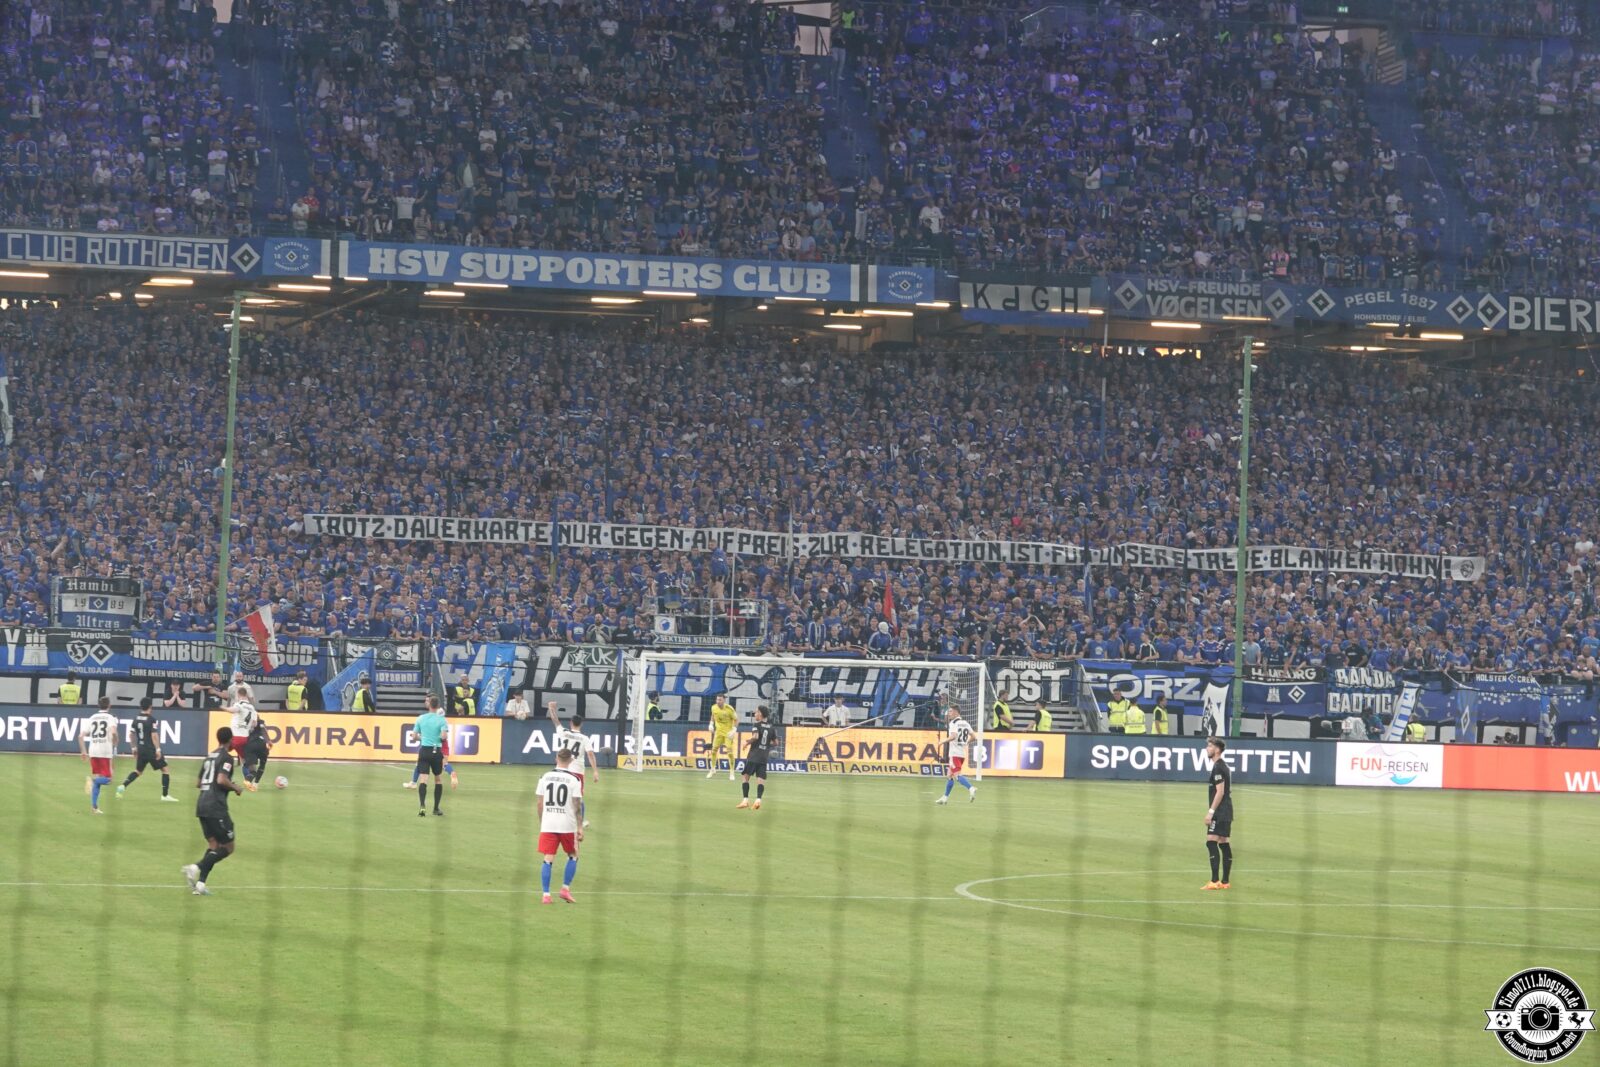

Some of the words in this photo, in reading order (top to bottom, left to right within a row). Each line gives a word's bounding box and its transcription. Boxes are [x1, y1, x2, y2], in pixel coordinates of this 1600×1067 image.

[7, 233, 77, 262] CLUB
[87, 237, 229, 270] ROTHOSEN
[368, 248, 450, 277] HSV
[460, 252, 723, 290] SUPPORTERS
[733, 264, 831, 294] CLUB
[1344, 291, 1395, 308] PEGEL
[1400, 293, 1438, 311] 1887
[1508, 296, 1600, 333] BIER
[312, 516, 385, 538] TROTZ
[394, 518, 548, 543] DAUERKARTE
[558, 524, 601, 544] NUR
[611, 526, 684, 549] GEGEN
[808, 535, 849, 555] ZUR
[860, 536, 1000, 562] RELEGATION
[1010, 543, 1043, 562] IST
[1192, 549, 1263, 569] TREE
[1270, 549, 1371, 569] BLANKER
[66, 578, 120, 593] Hamb
[70, 631, 112, 640] HAMBURG
[660, 634, 690, 643] SEKTION
[865, 653, 912, 661] ULTRAS
[1011, 660, 1056, 670] HAMBURG
[166, 670, 213, 680] VERSTORBENE
[1335, 666, 1396, 688] BANDA
[1475, 673, 1507, 683] HOLSTEN
[996, 668, 1070, 703] OST
[91, 720, 108, 738] 23
[264, 725, 393, 750] DMIRAL
[957, 727, 969, 743] 28
[810, 762, 839, 772] BET
[850, 763, 918, 774] ADMIRAL
[1090, 745, 1311, 774] SPORTWETTEN
[545, 782, 568, 807] 10
